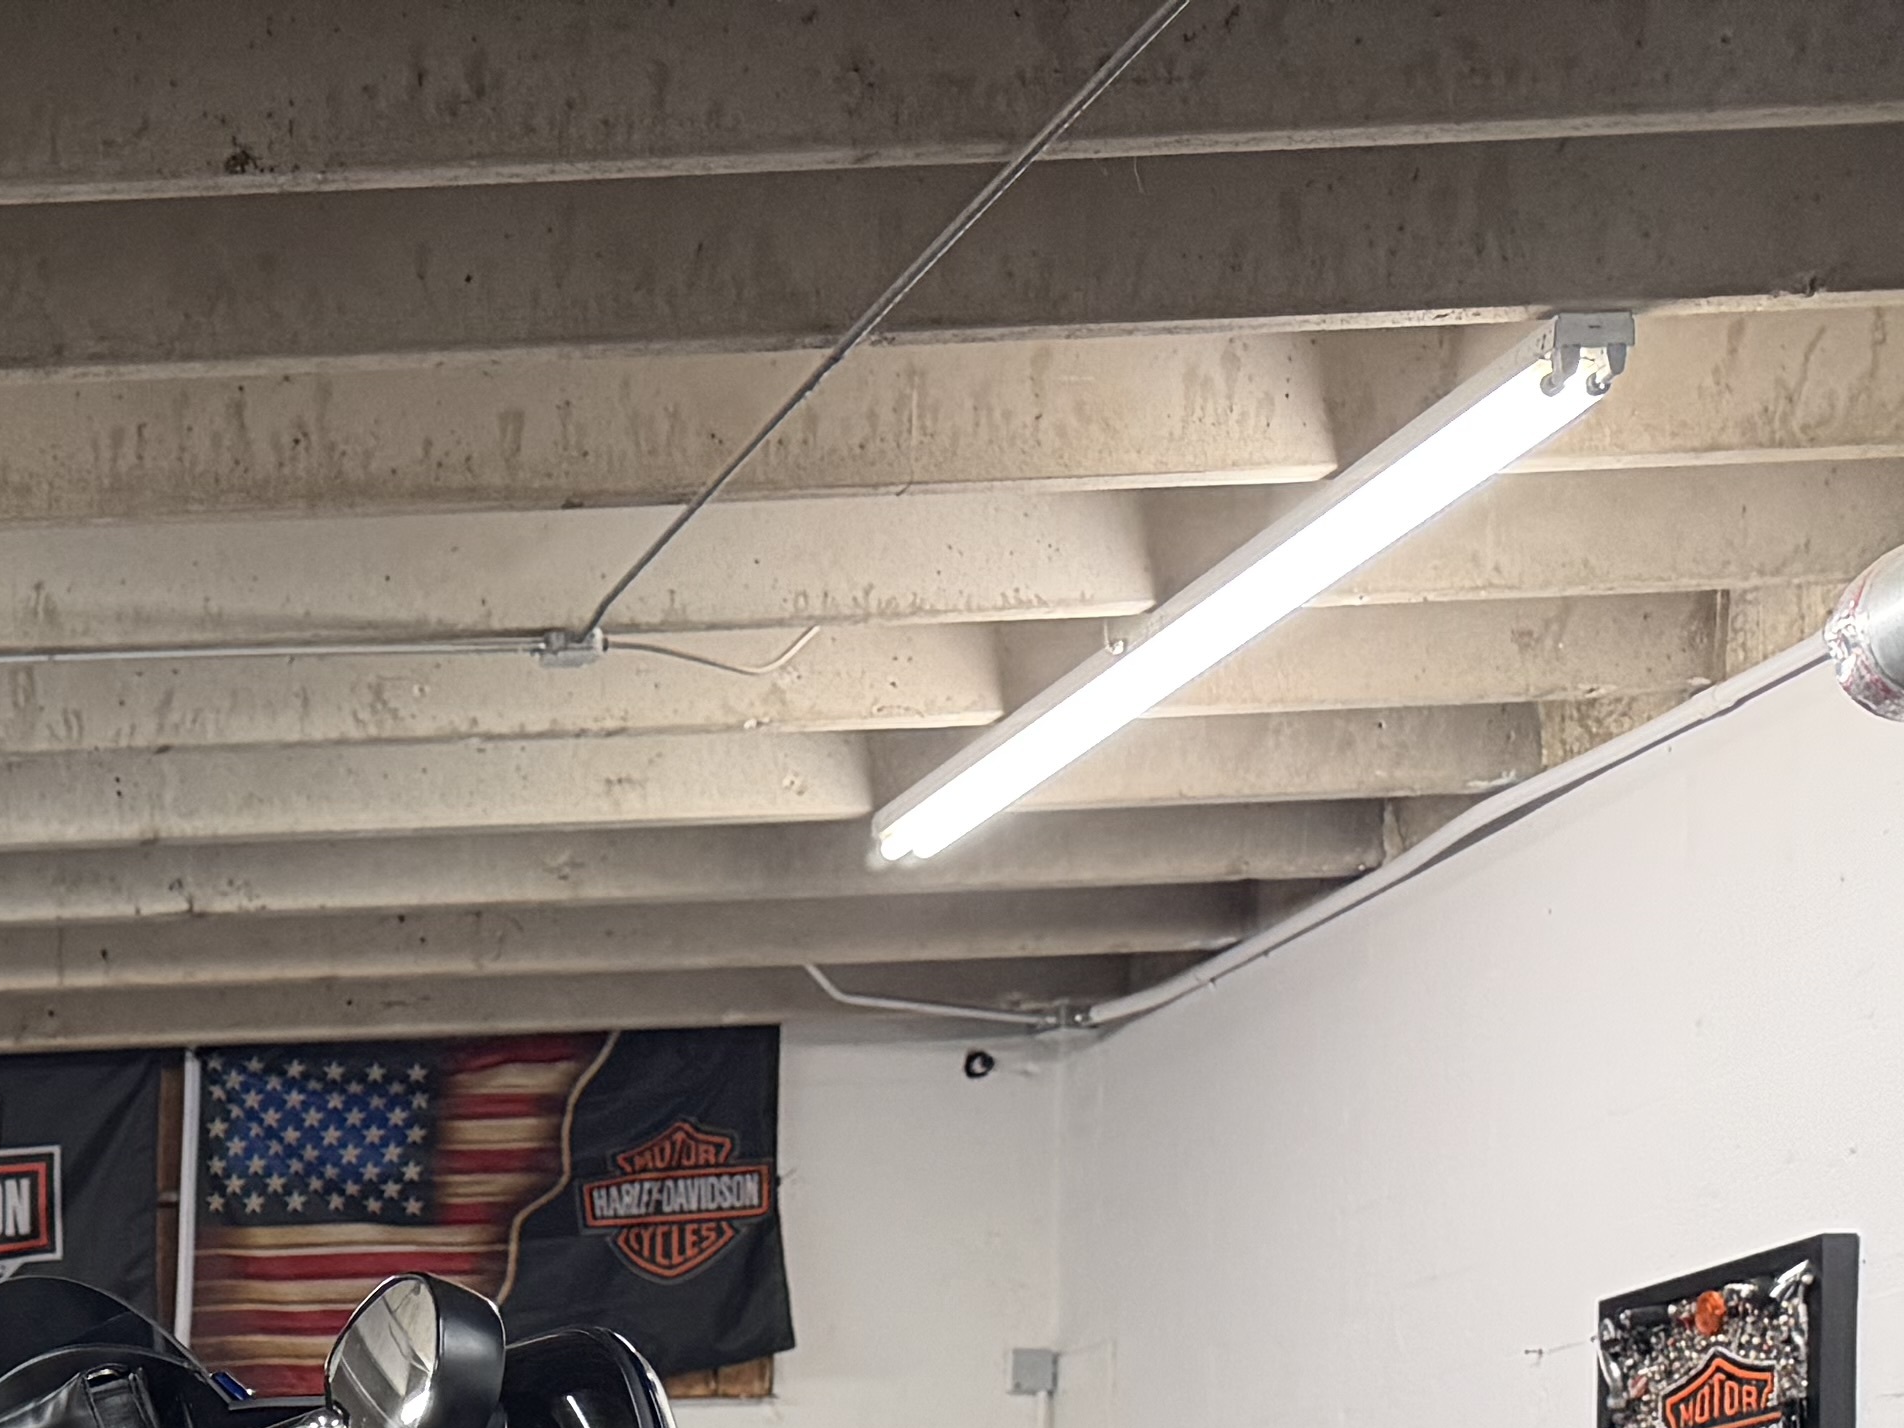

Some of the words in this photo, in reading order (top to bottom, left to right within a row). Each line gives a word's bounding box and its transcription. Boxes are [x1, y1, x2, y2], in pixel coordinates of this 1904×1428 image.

[633, 1131, 717, 1171] MOTOR
[593, 1173, 759, 1218] HARLEY-DAVIDSON
[628, 1222, 717, 1265] CYCLES
[1679, 1373, 1759, 1426] MOTOR
